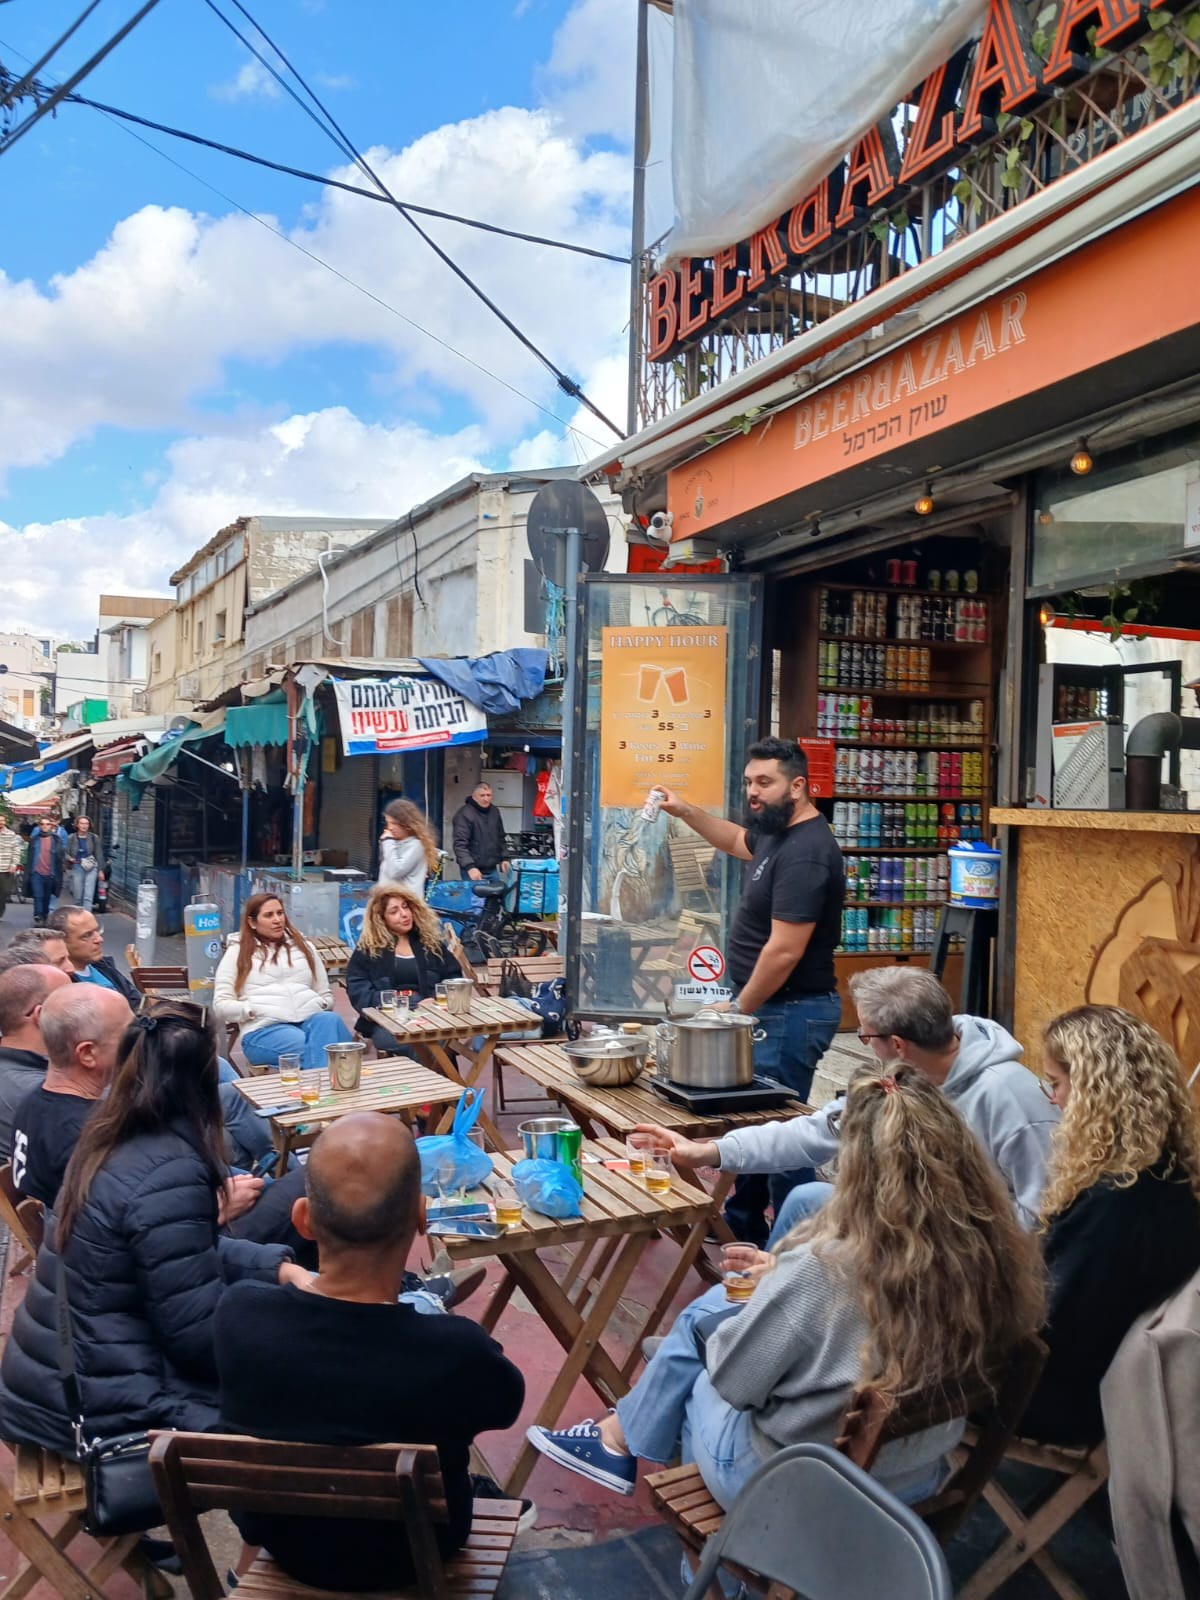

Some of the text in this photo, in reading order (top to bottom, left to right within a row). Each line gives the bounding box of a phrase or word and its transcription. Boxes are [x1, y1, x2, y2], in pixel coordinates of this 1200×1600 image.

[793, 292, 1028, 450] BEERBAZAAR
[843, 394, 948, 456] שוק הכרמל
[610, 633, 719, 648] HAPPY HOUR
[351, 684, 393, 708] אותם
[413, 699, 469, 731] הביתה
[710, 987, 732, 996] אסור
